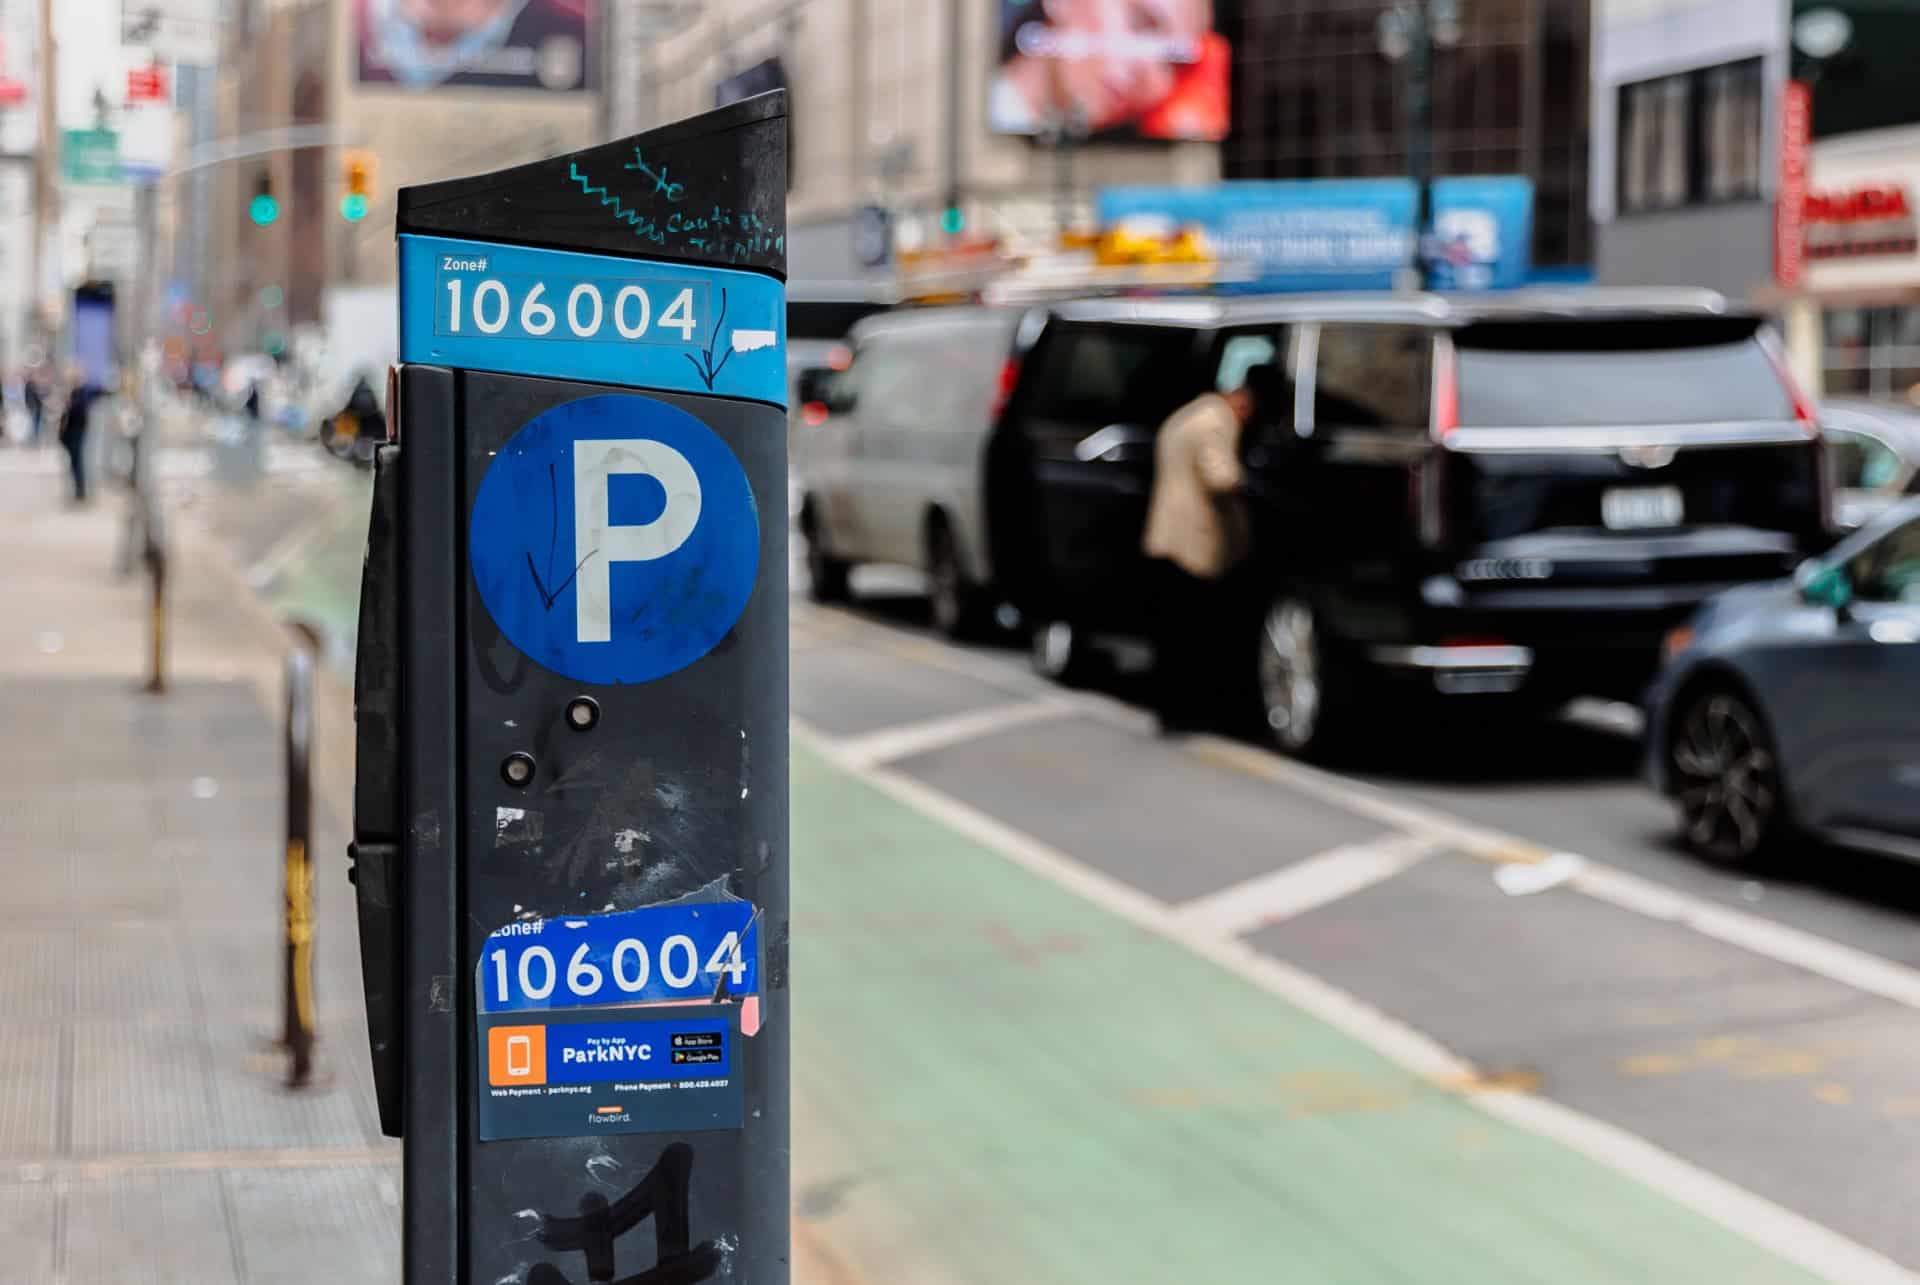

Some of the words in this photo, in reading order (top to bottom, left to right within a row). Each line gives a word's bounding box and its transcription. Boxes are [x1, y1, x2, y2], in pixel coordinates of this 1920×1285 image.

[443, 257, 488, 272] Zone#
[447, 279, 697, 340] 106004
[573, 439, 702, 643] P
[491, 931, 746, 1001] 106004
[612, 1036, 626, 1046] App
[563, 1044, 652, 1063] ParkNYC
[491, 1087, 508, 1096] Web
[509, 1088, 542, 1098] Payment
[614, 1084, 638, 1092] Phone
[639, 1082, 671, 1093] Payment
